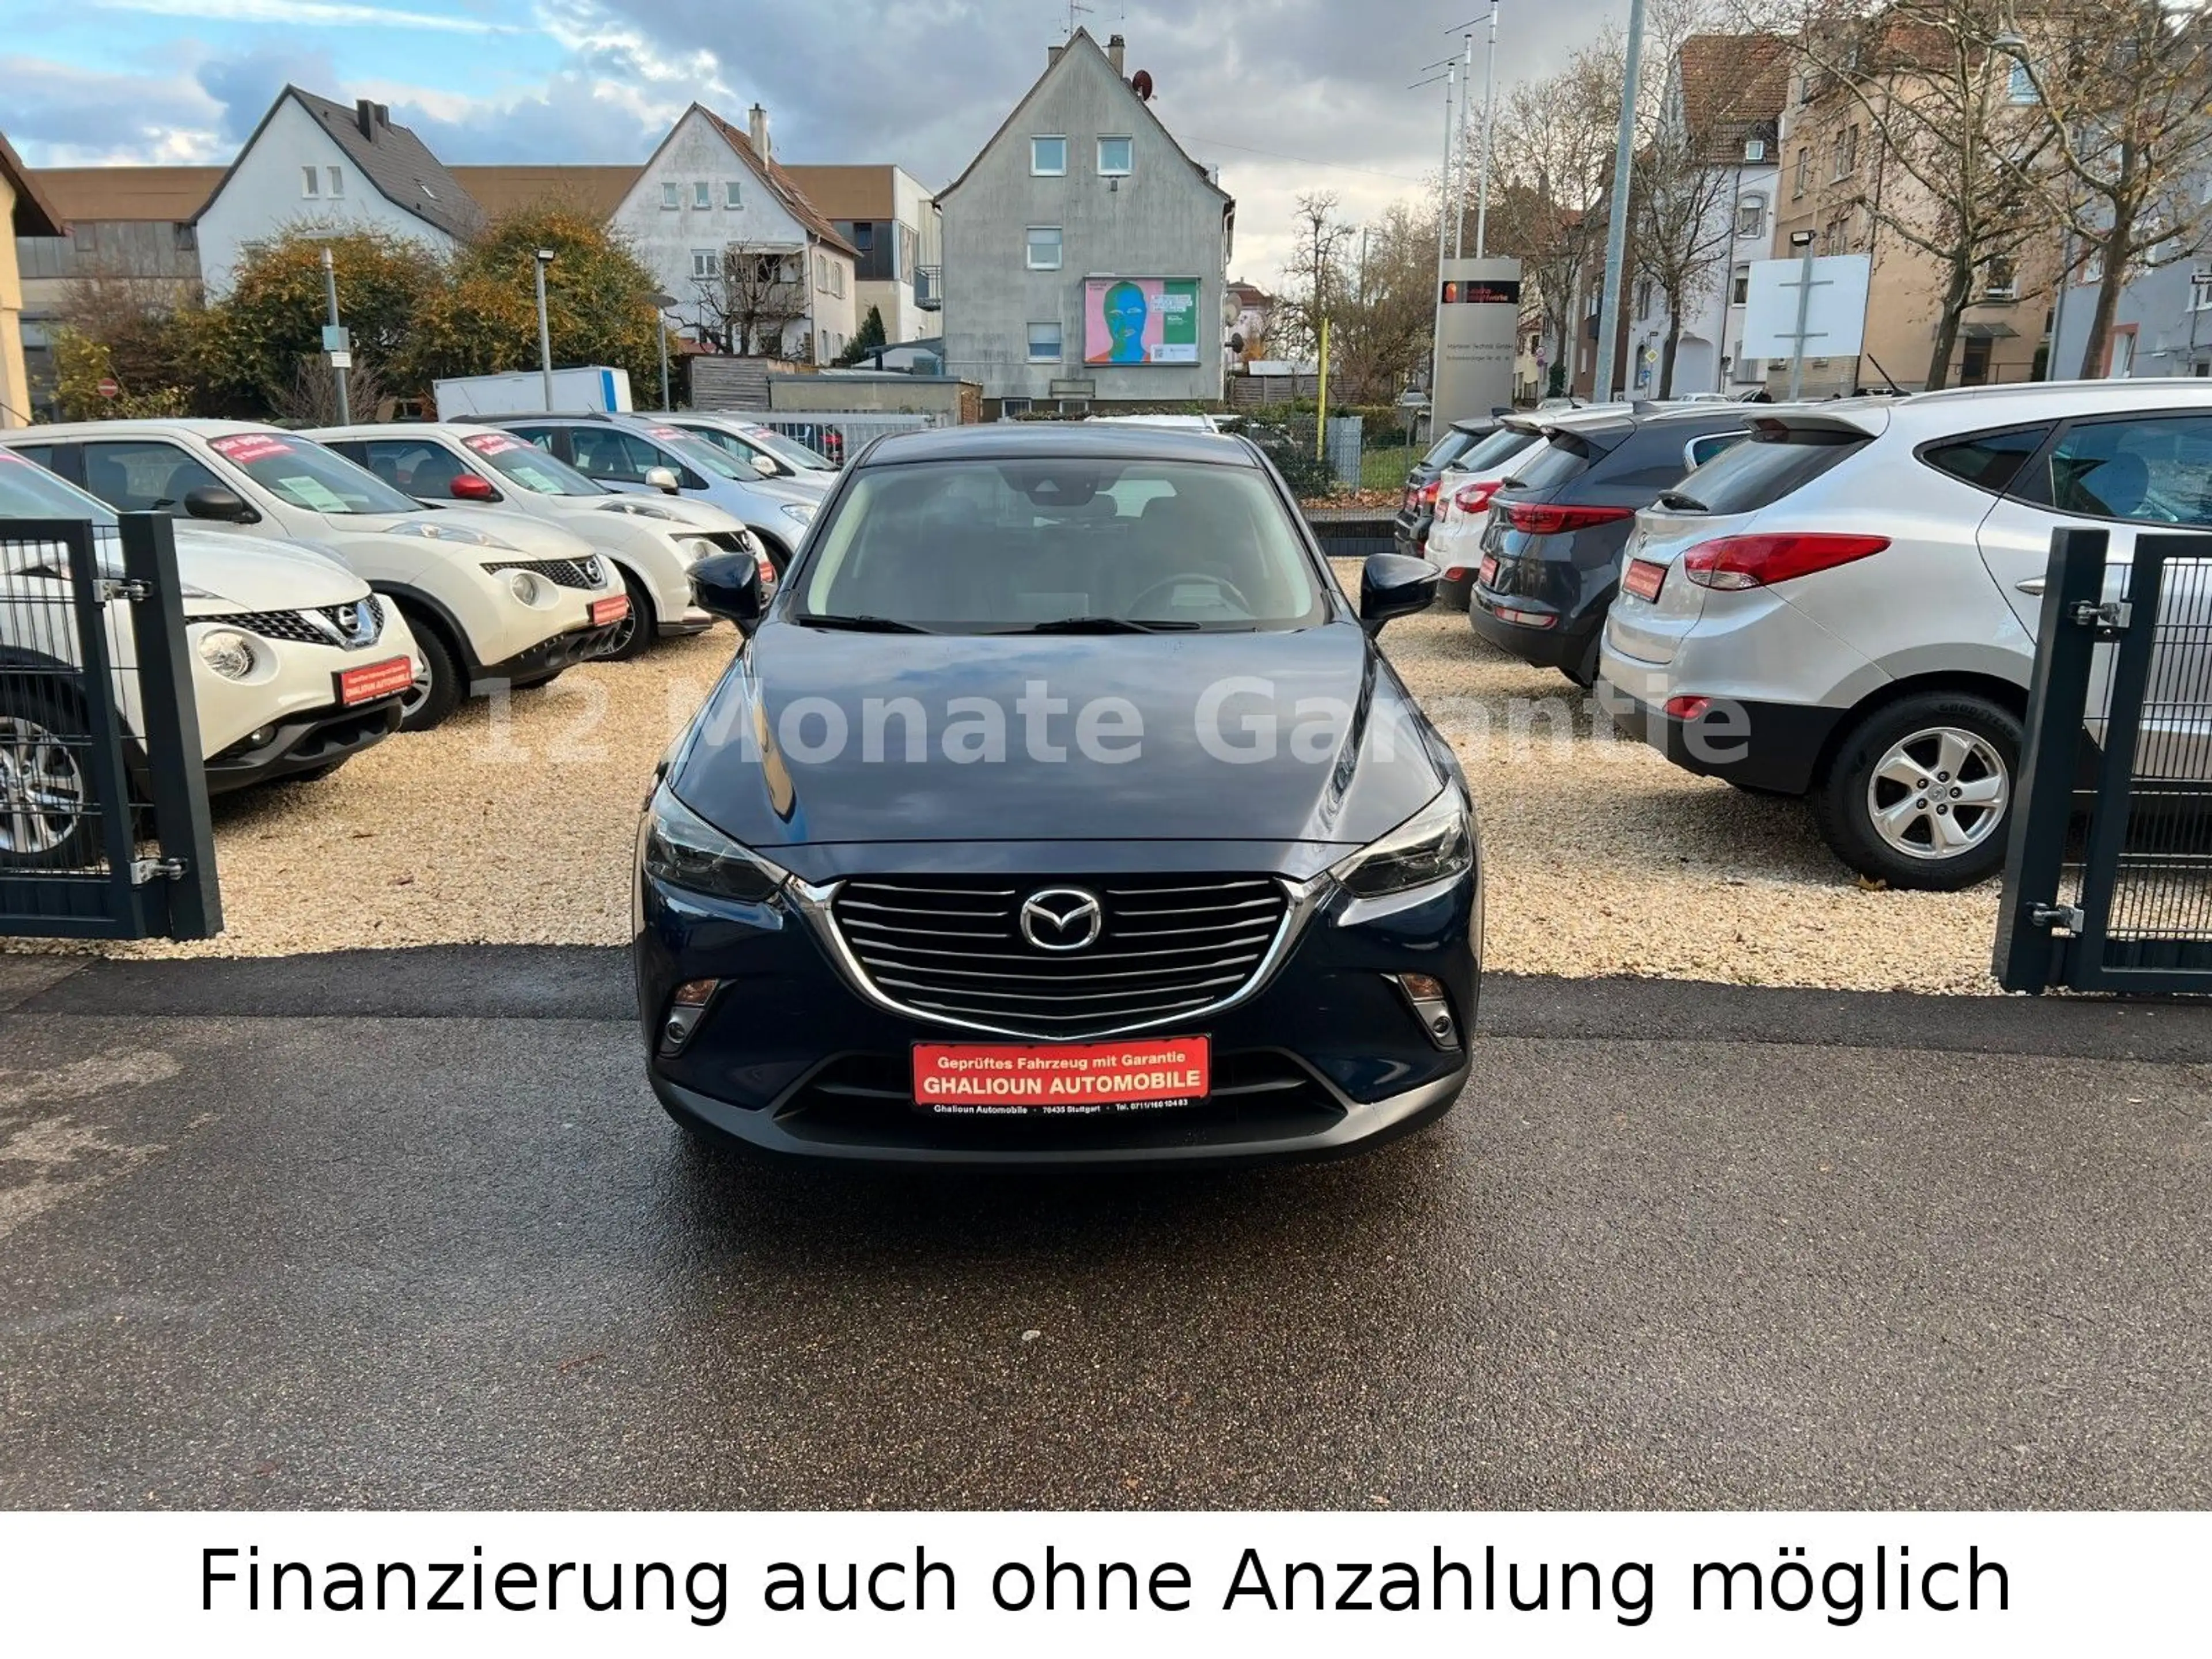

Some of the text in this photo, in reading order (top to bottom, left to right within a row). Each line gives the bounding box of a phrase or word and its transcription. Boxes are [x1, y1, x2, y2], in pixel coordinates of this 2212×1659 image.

[937, 1051, 1185, 1071] Geprüftes Fahrzeug mit Garantie
[923, 1069, 1200, 1095] GHALIOUN AUTOMOBILE
[934, 1104, 975, 1113] Ghalioun
[976, 1105, 1028, 1114] Automobile
[1066, 1105, 1101, 1115] Stuttgart
